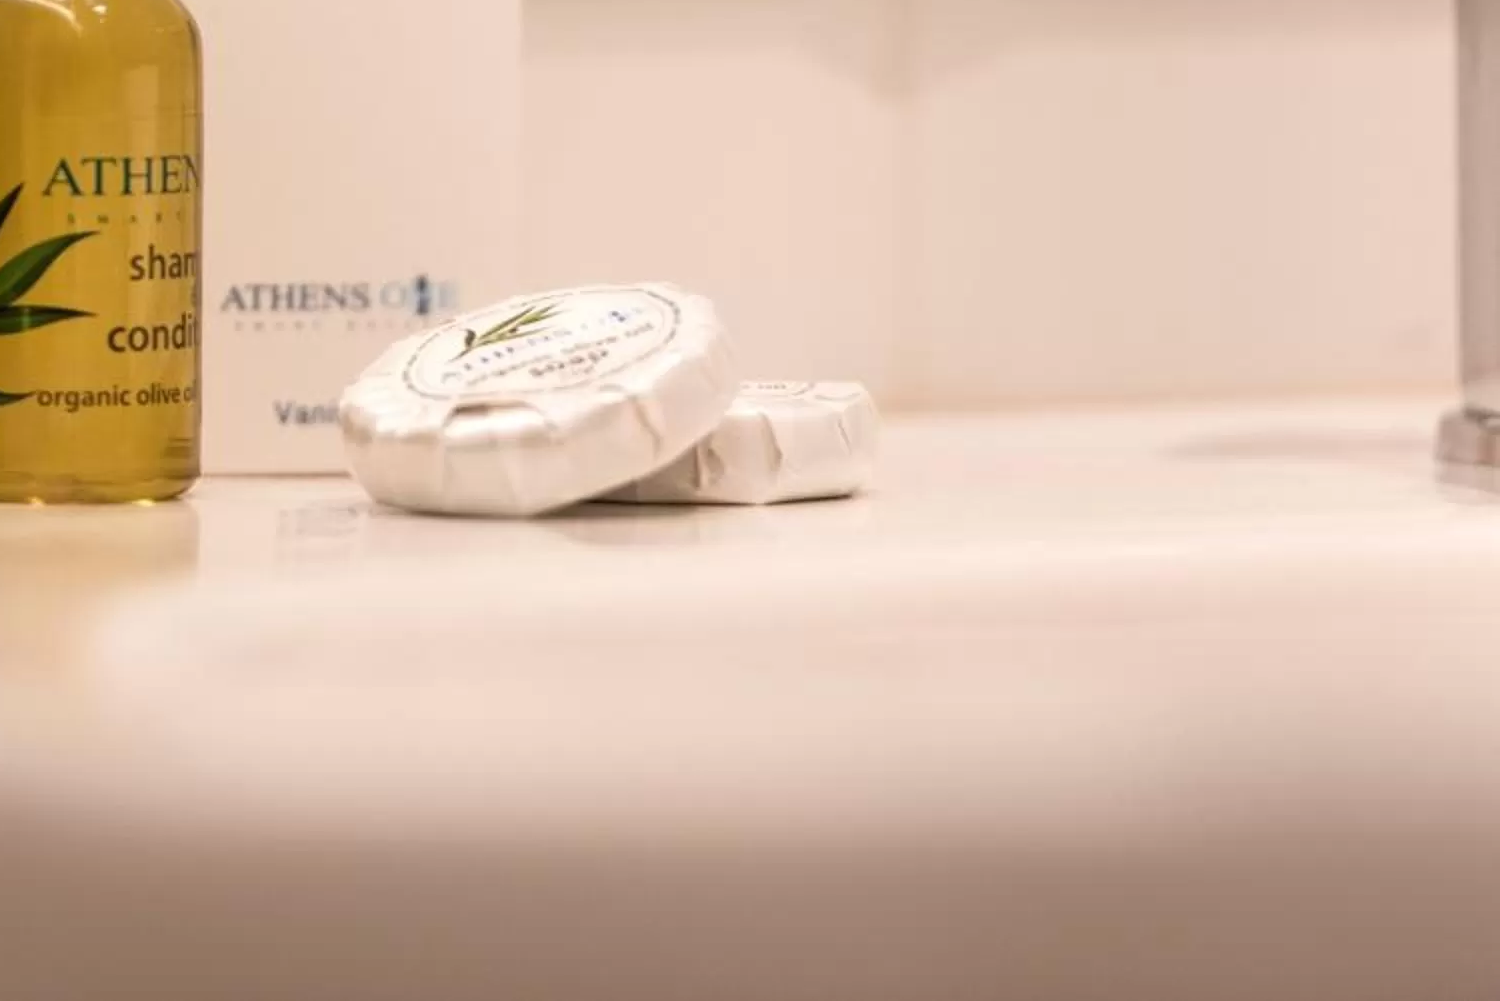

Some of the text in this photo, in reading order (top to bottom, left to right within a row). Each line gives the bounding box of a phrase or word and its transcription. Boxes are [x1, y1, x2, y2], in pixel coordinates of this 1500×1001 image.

[220, 283, 370, 313] ATHENS
[36, 385, 131, 413] organic
[136, 381, 181, 406] olive
